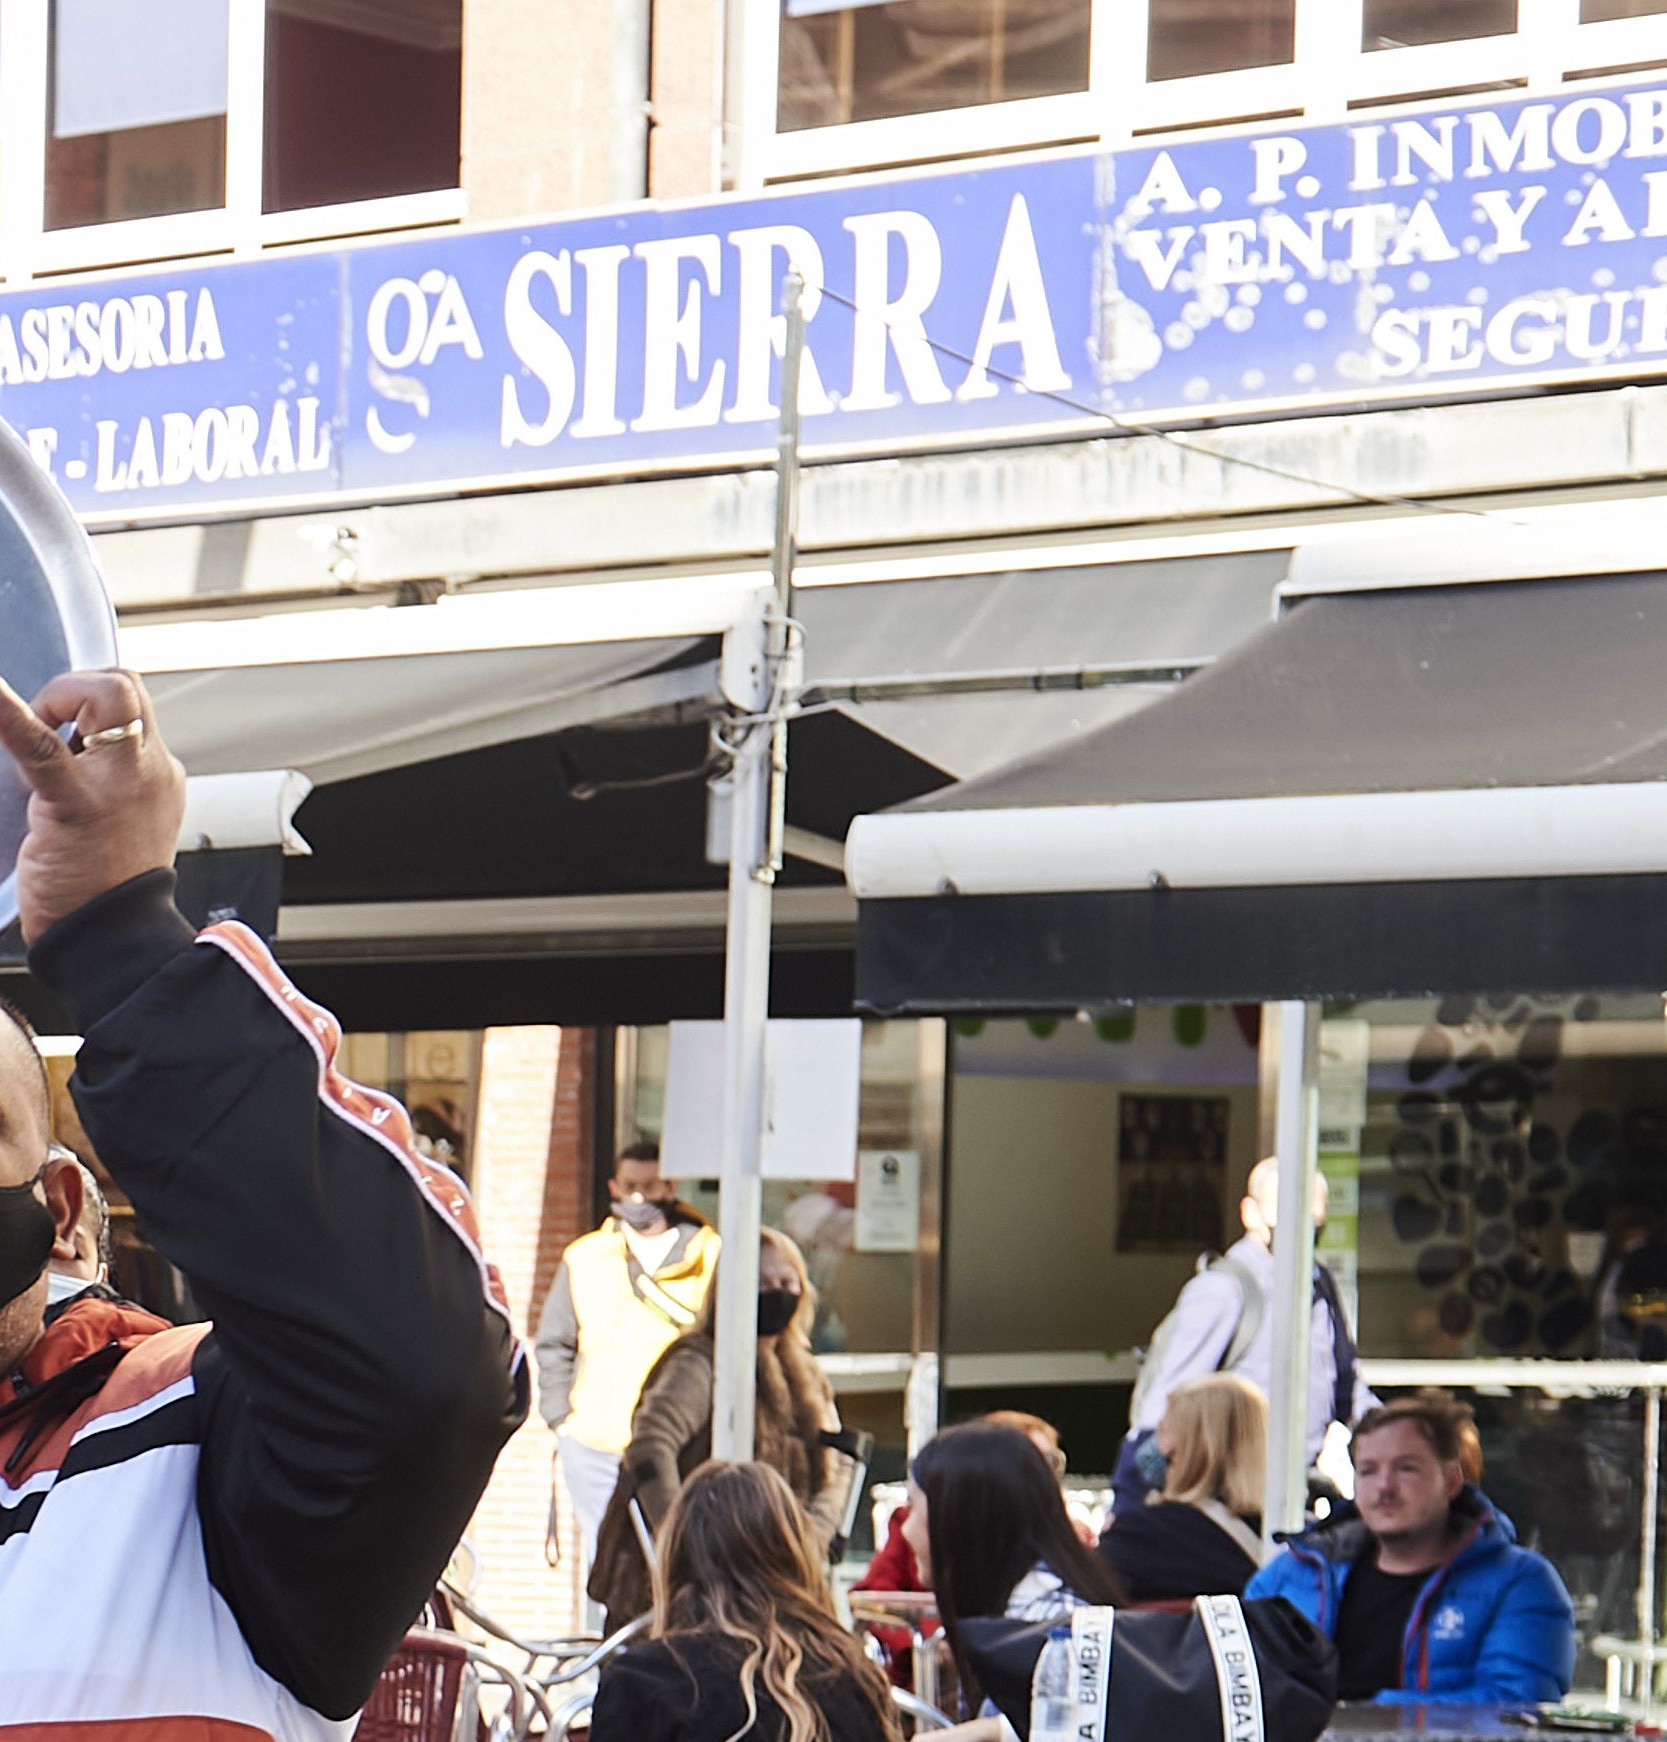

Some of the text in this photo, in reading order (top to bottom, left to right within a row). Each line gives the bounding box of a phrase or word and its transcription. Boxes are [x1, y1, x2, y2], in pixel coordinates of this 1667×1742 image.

[1249, 136, 1321, 203] P.
[1130, 199, 1461, 291] VENTA
[1473, 185, 1547, 255] Y
[499, 192, 1073, 450] SIERRA
[94, 397, 332, 493] LABORAL
